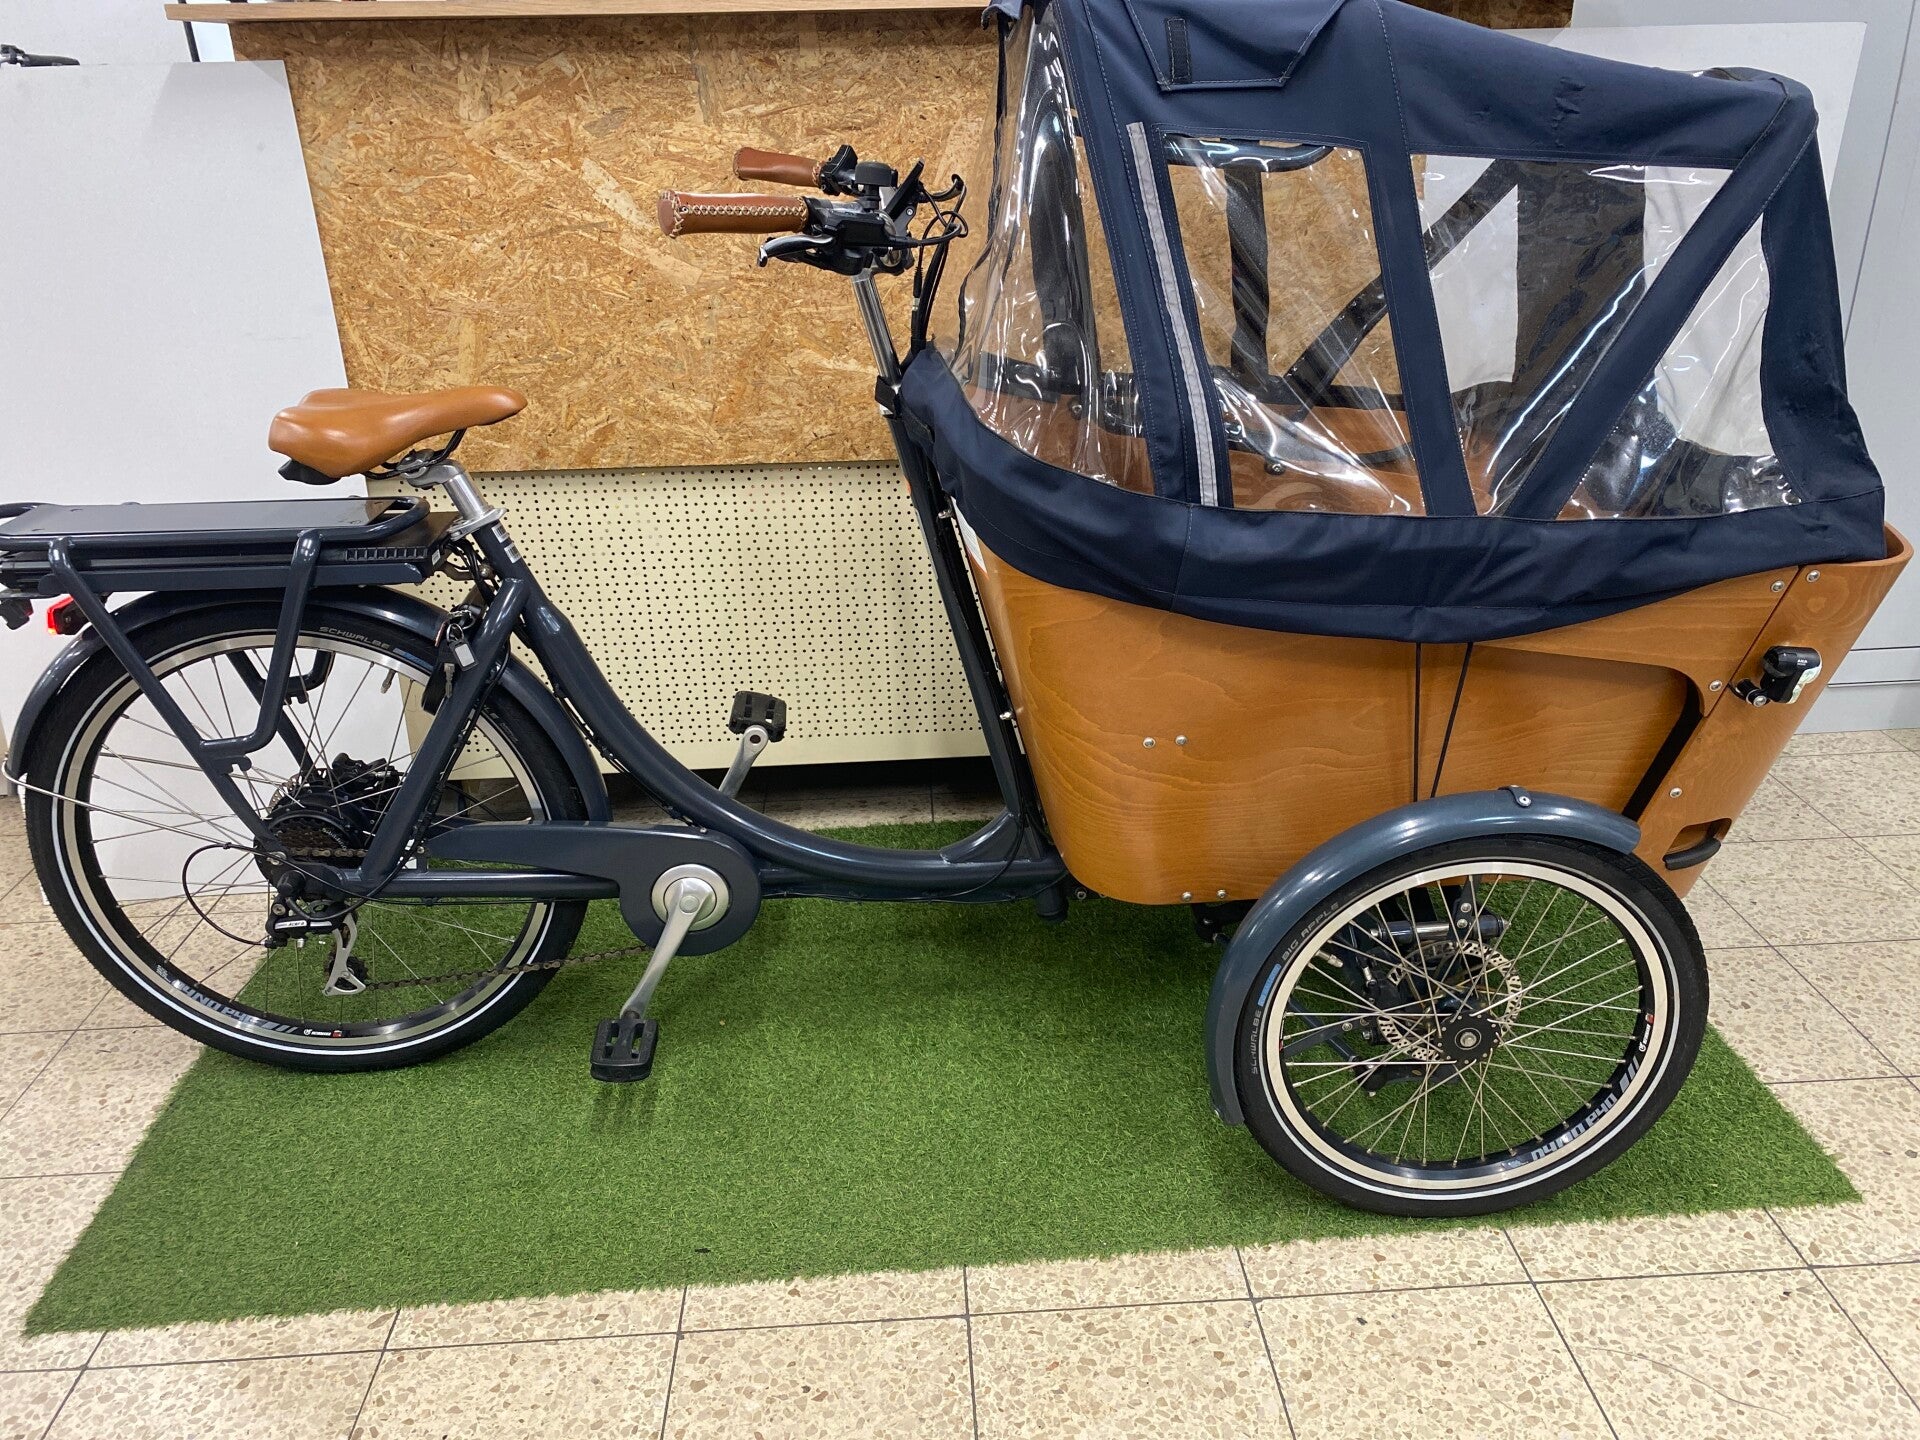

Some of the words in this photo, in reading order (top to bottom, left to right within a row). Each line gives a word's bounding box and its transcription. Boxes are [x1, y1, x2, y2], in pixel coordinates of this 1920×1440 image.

[319, 626, 391, 649] SCHWALBE
[1282, 939, 1299, 961] BIG
[1301, 902, 1339, 939] APPLE
[1250, 1009, 1262, 1075] SCHWALBE
